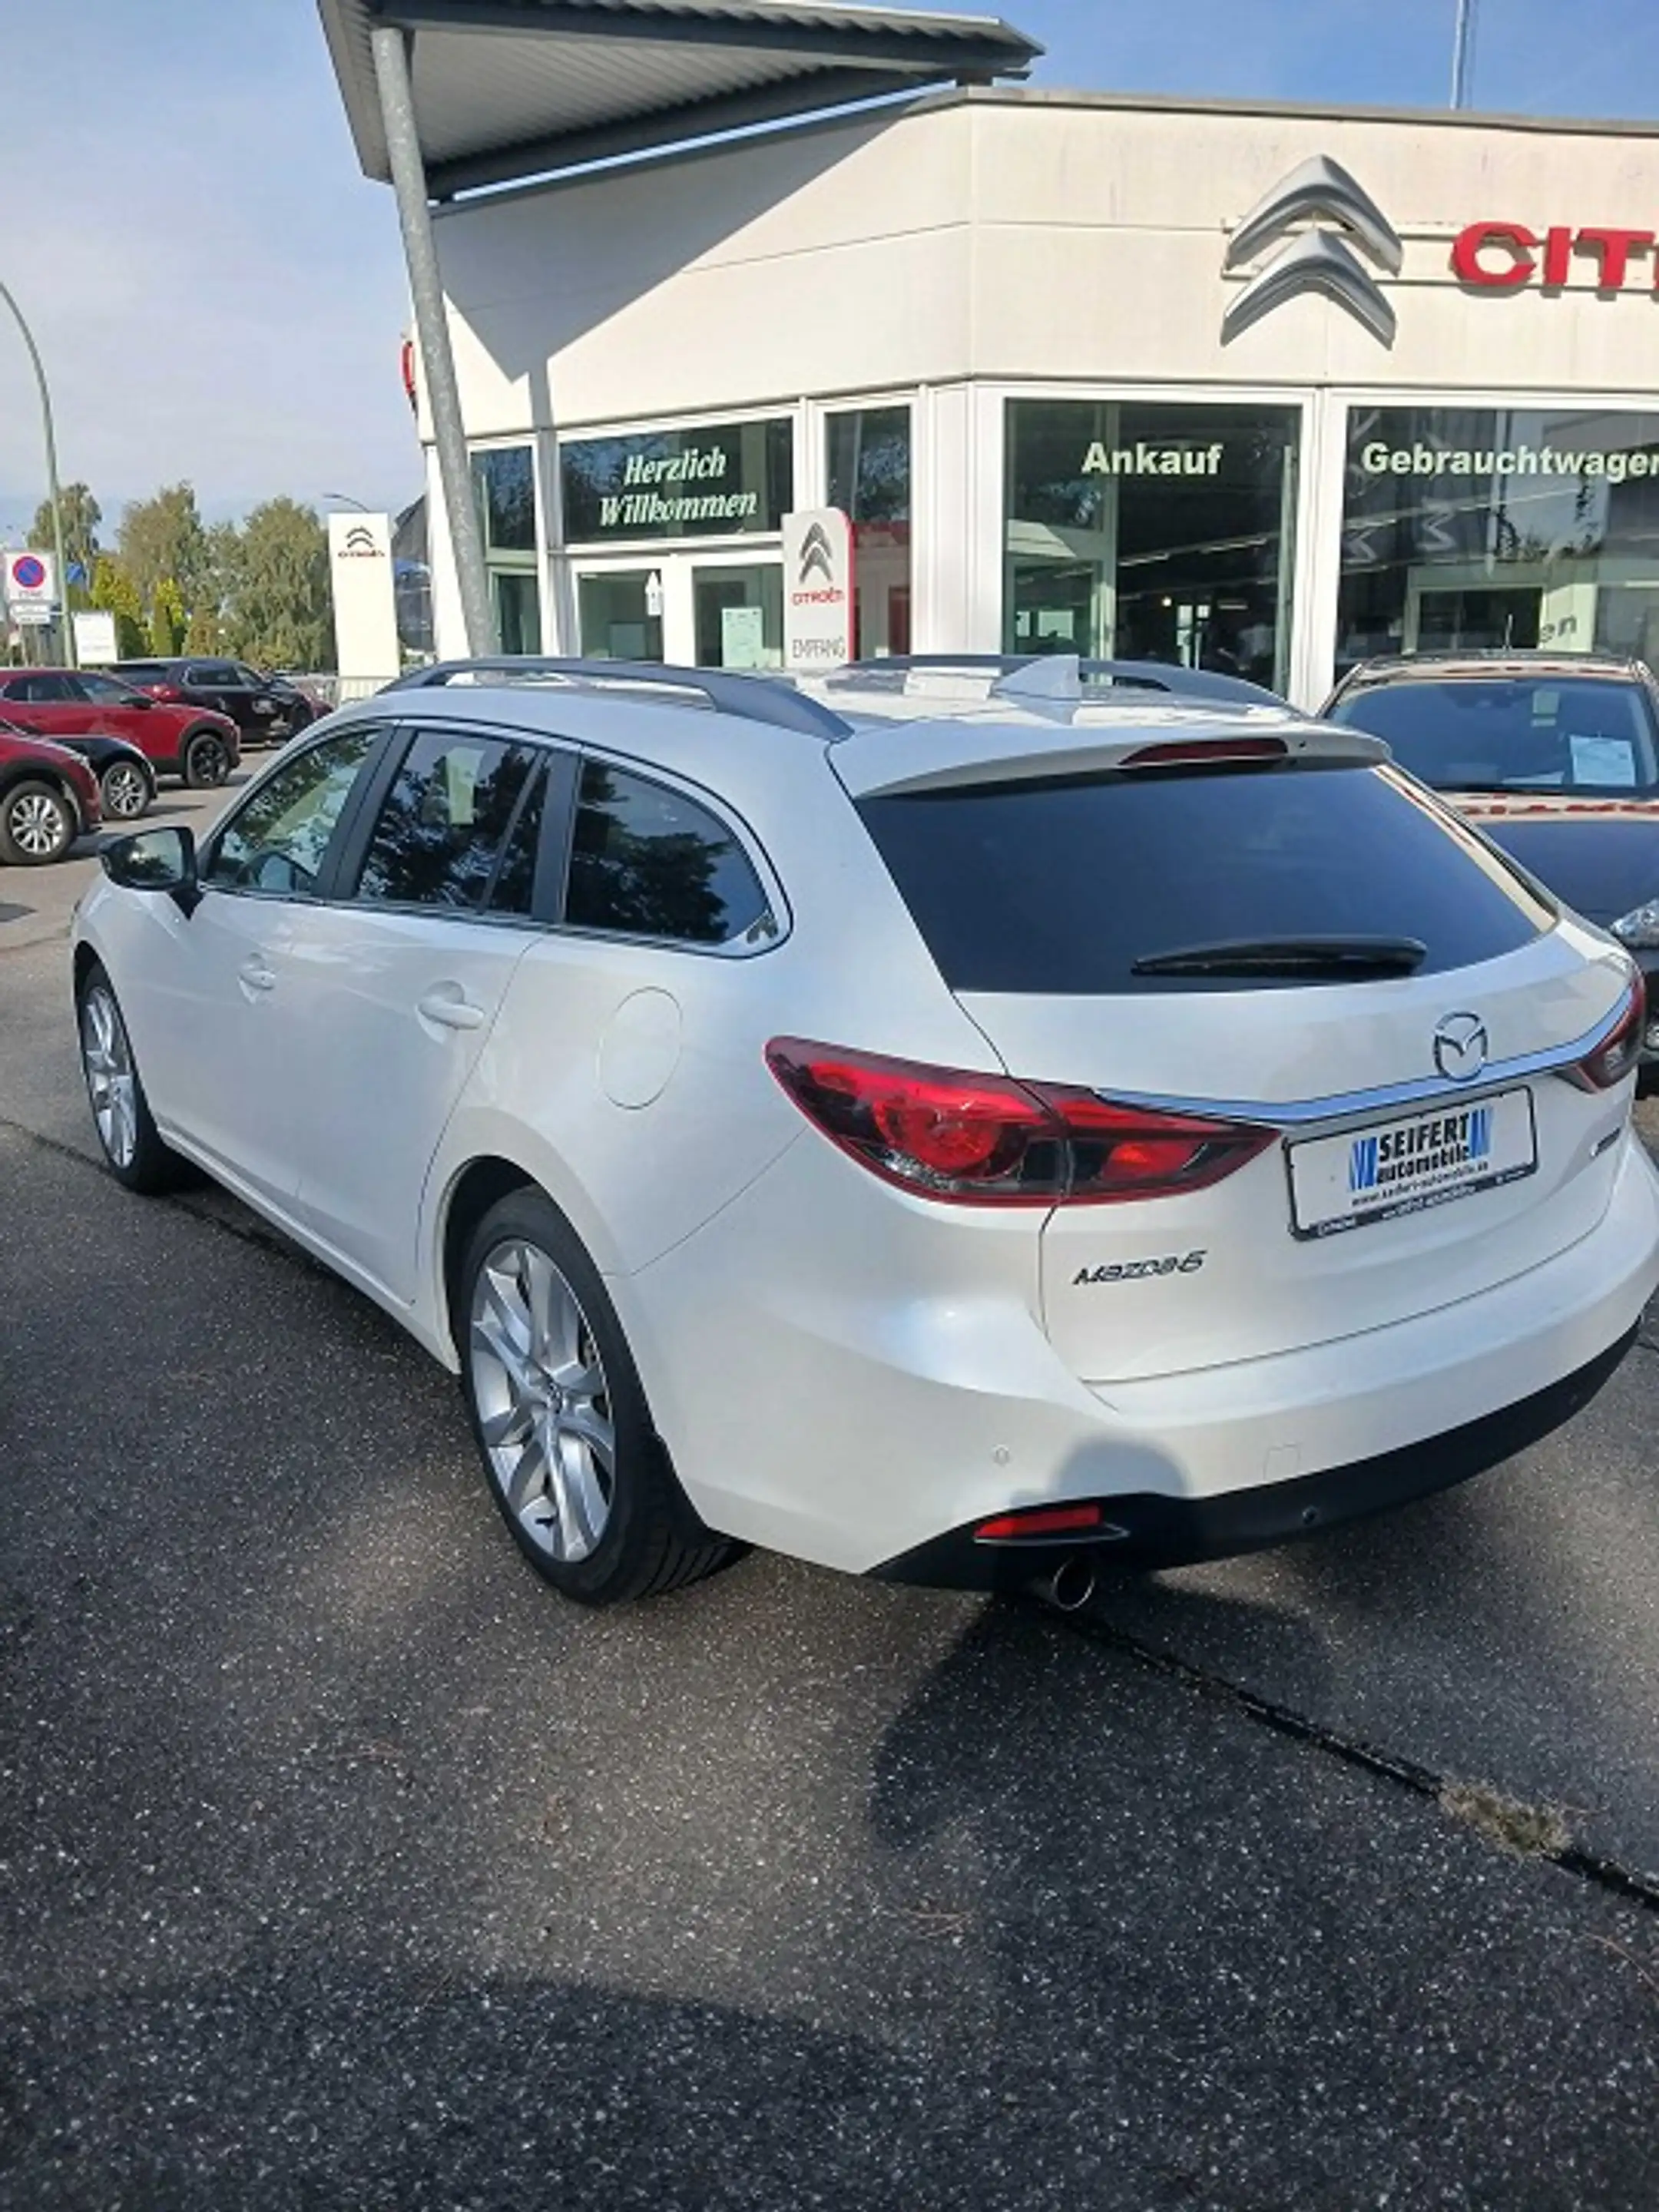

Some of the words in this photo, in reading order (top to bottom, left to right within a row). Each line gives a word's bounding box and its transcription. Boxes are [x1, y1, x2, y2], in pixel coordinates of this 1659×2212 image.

[1451, 220, 1659, 292] CIT
[623, 444, 727, 487] Herzlich
[1081, 442, 1224, 475] Ankauf
[598, 492, 757, 527] Willkommen
[1379, 1111, 1470, 1163] SEIFERT
[1376, 1143, 1471, 1185] automobile
